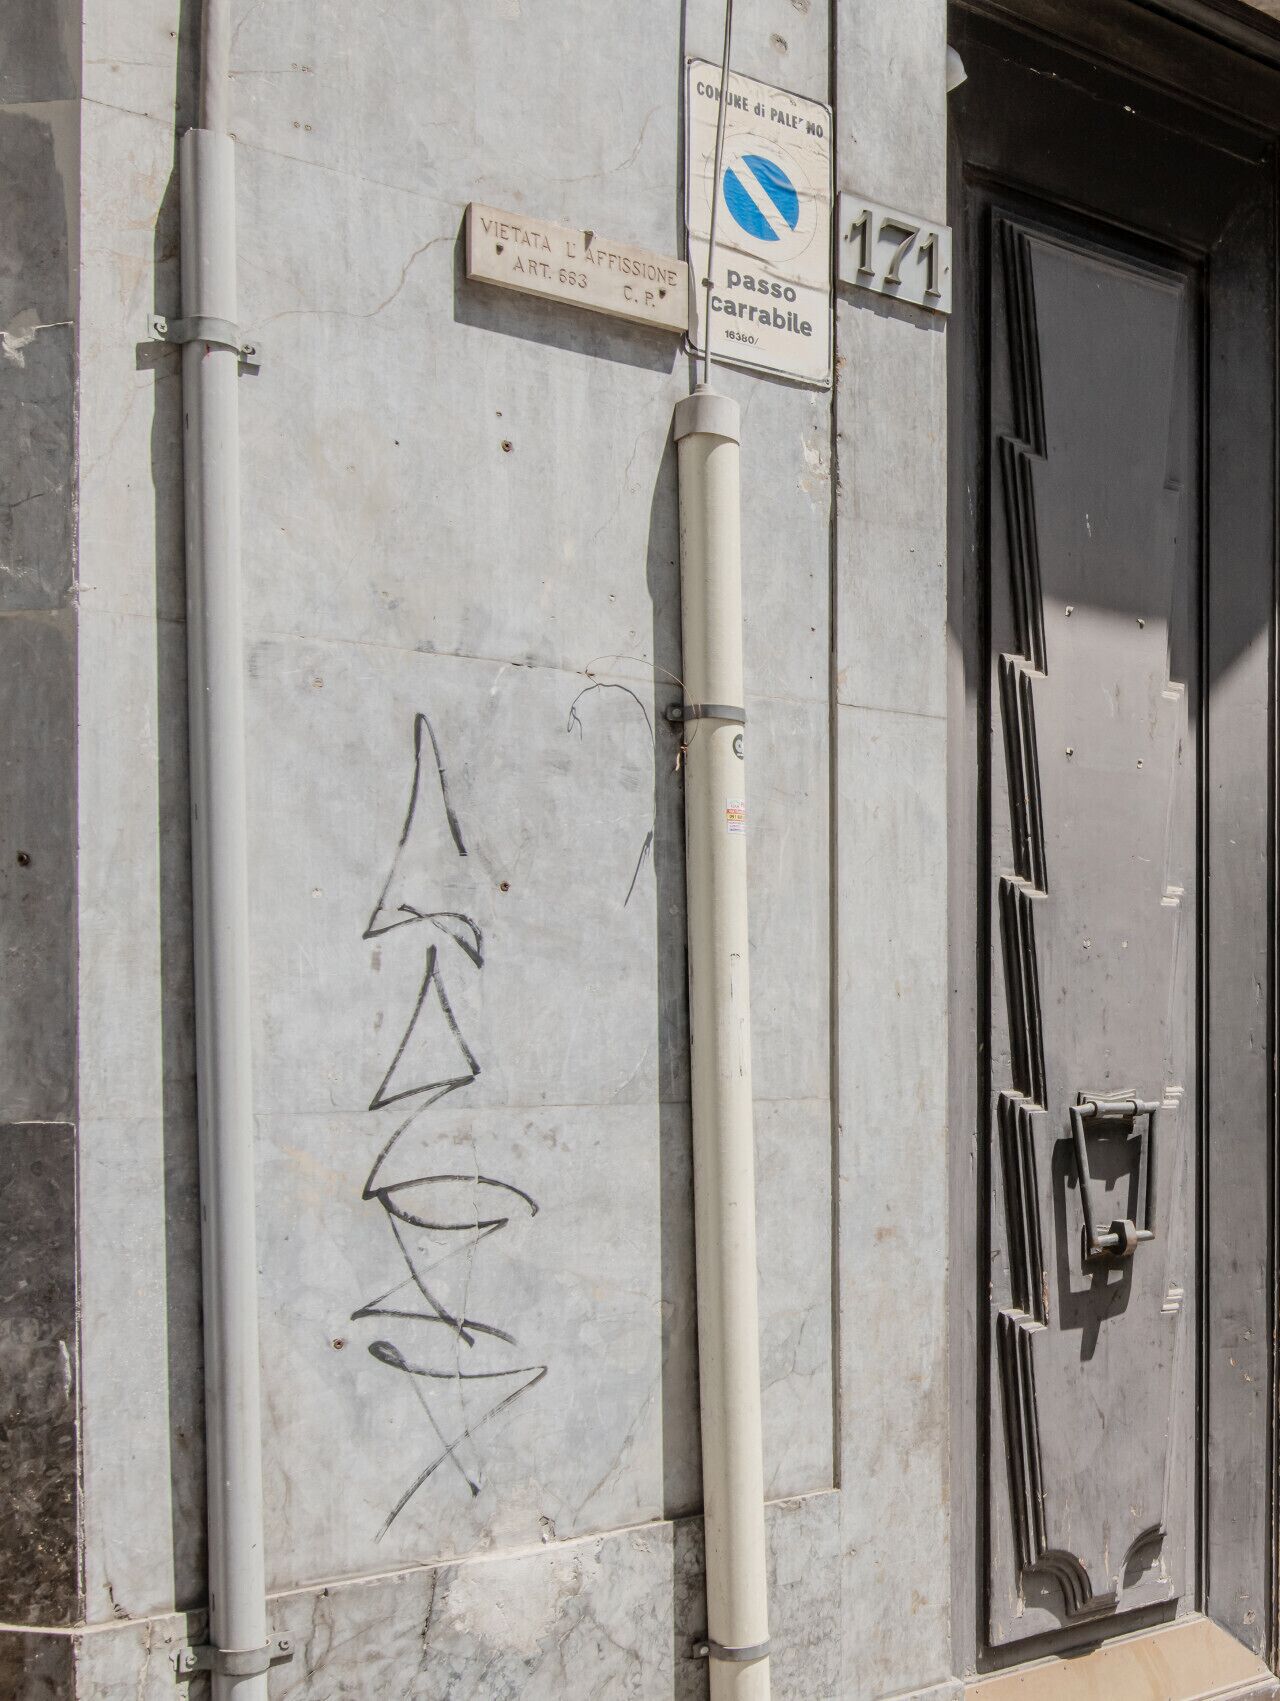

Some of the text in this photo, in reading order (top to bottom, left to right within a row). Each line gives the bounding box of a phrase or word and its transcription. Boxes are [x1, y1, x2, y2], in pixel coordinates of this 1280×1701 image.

[753, 102, 766, 118] di
[770, 107, 824, 138] PALEMO
[480, 217, 551, 253] VIETATA
[852, 210, 941, 298] 171
[513, 256, 552, 280] ART.
[559, 268, 588, 289] 663
[727, 269, 797, 303] passo
[711, 295, 813, 337] carrabile
